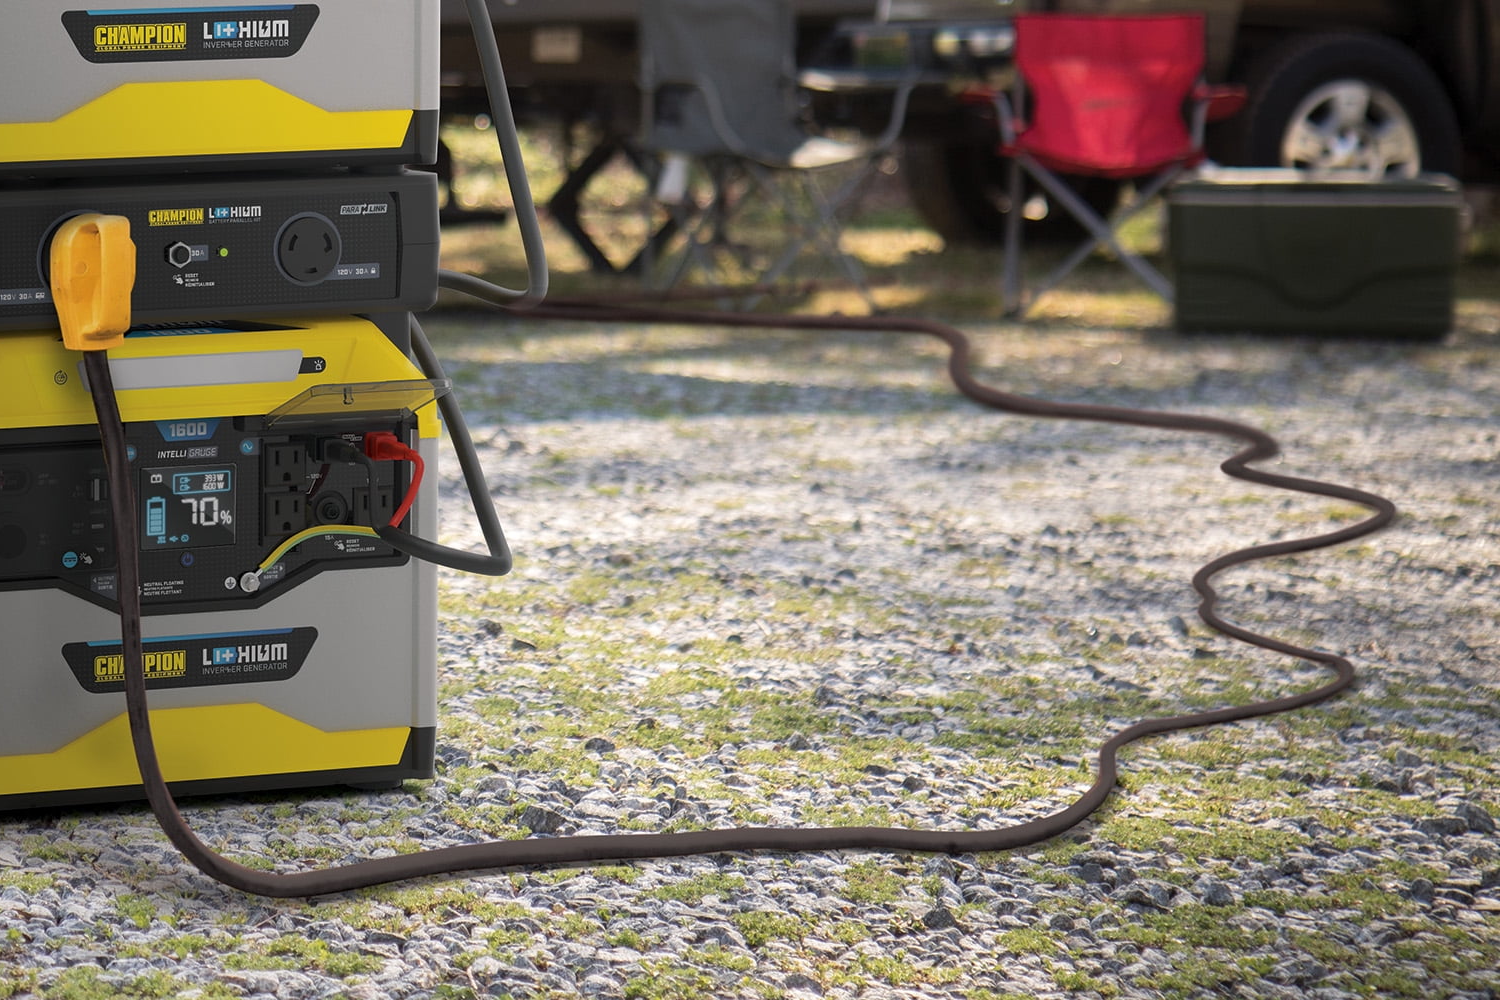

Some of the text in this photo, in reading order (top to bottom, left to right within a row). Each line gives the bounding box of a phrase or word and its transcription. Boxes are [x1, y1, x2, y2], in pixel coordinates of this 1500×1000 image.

[96, 25, 185, 46] CHAMPION
[244, 39, 289, 48] GENERATOR
[149, 208, 204, 223] CHAMPION
[337, 268, 353, 276] 120V
[0, 293, 17, 301] 120V
[169, 422, 207, 437] 1600
[157, 447, 218, 459] INTELLI GAUGE
[243, 662, 288, 672] GENERATOR
